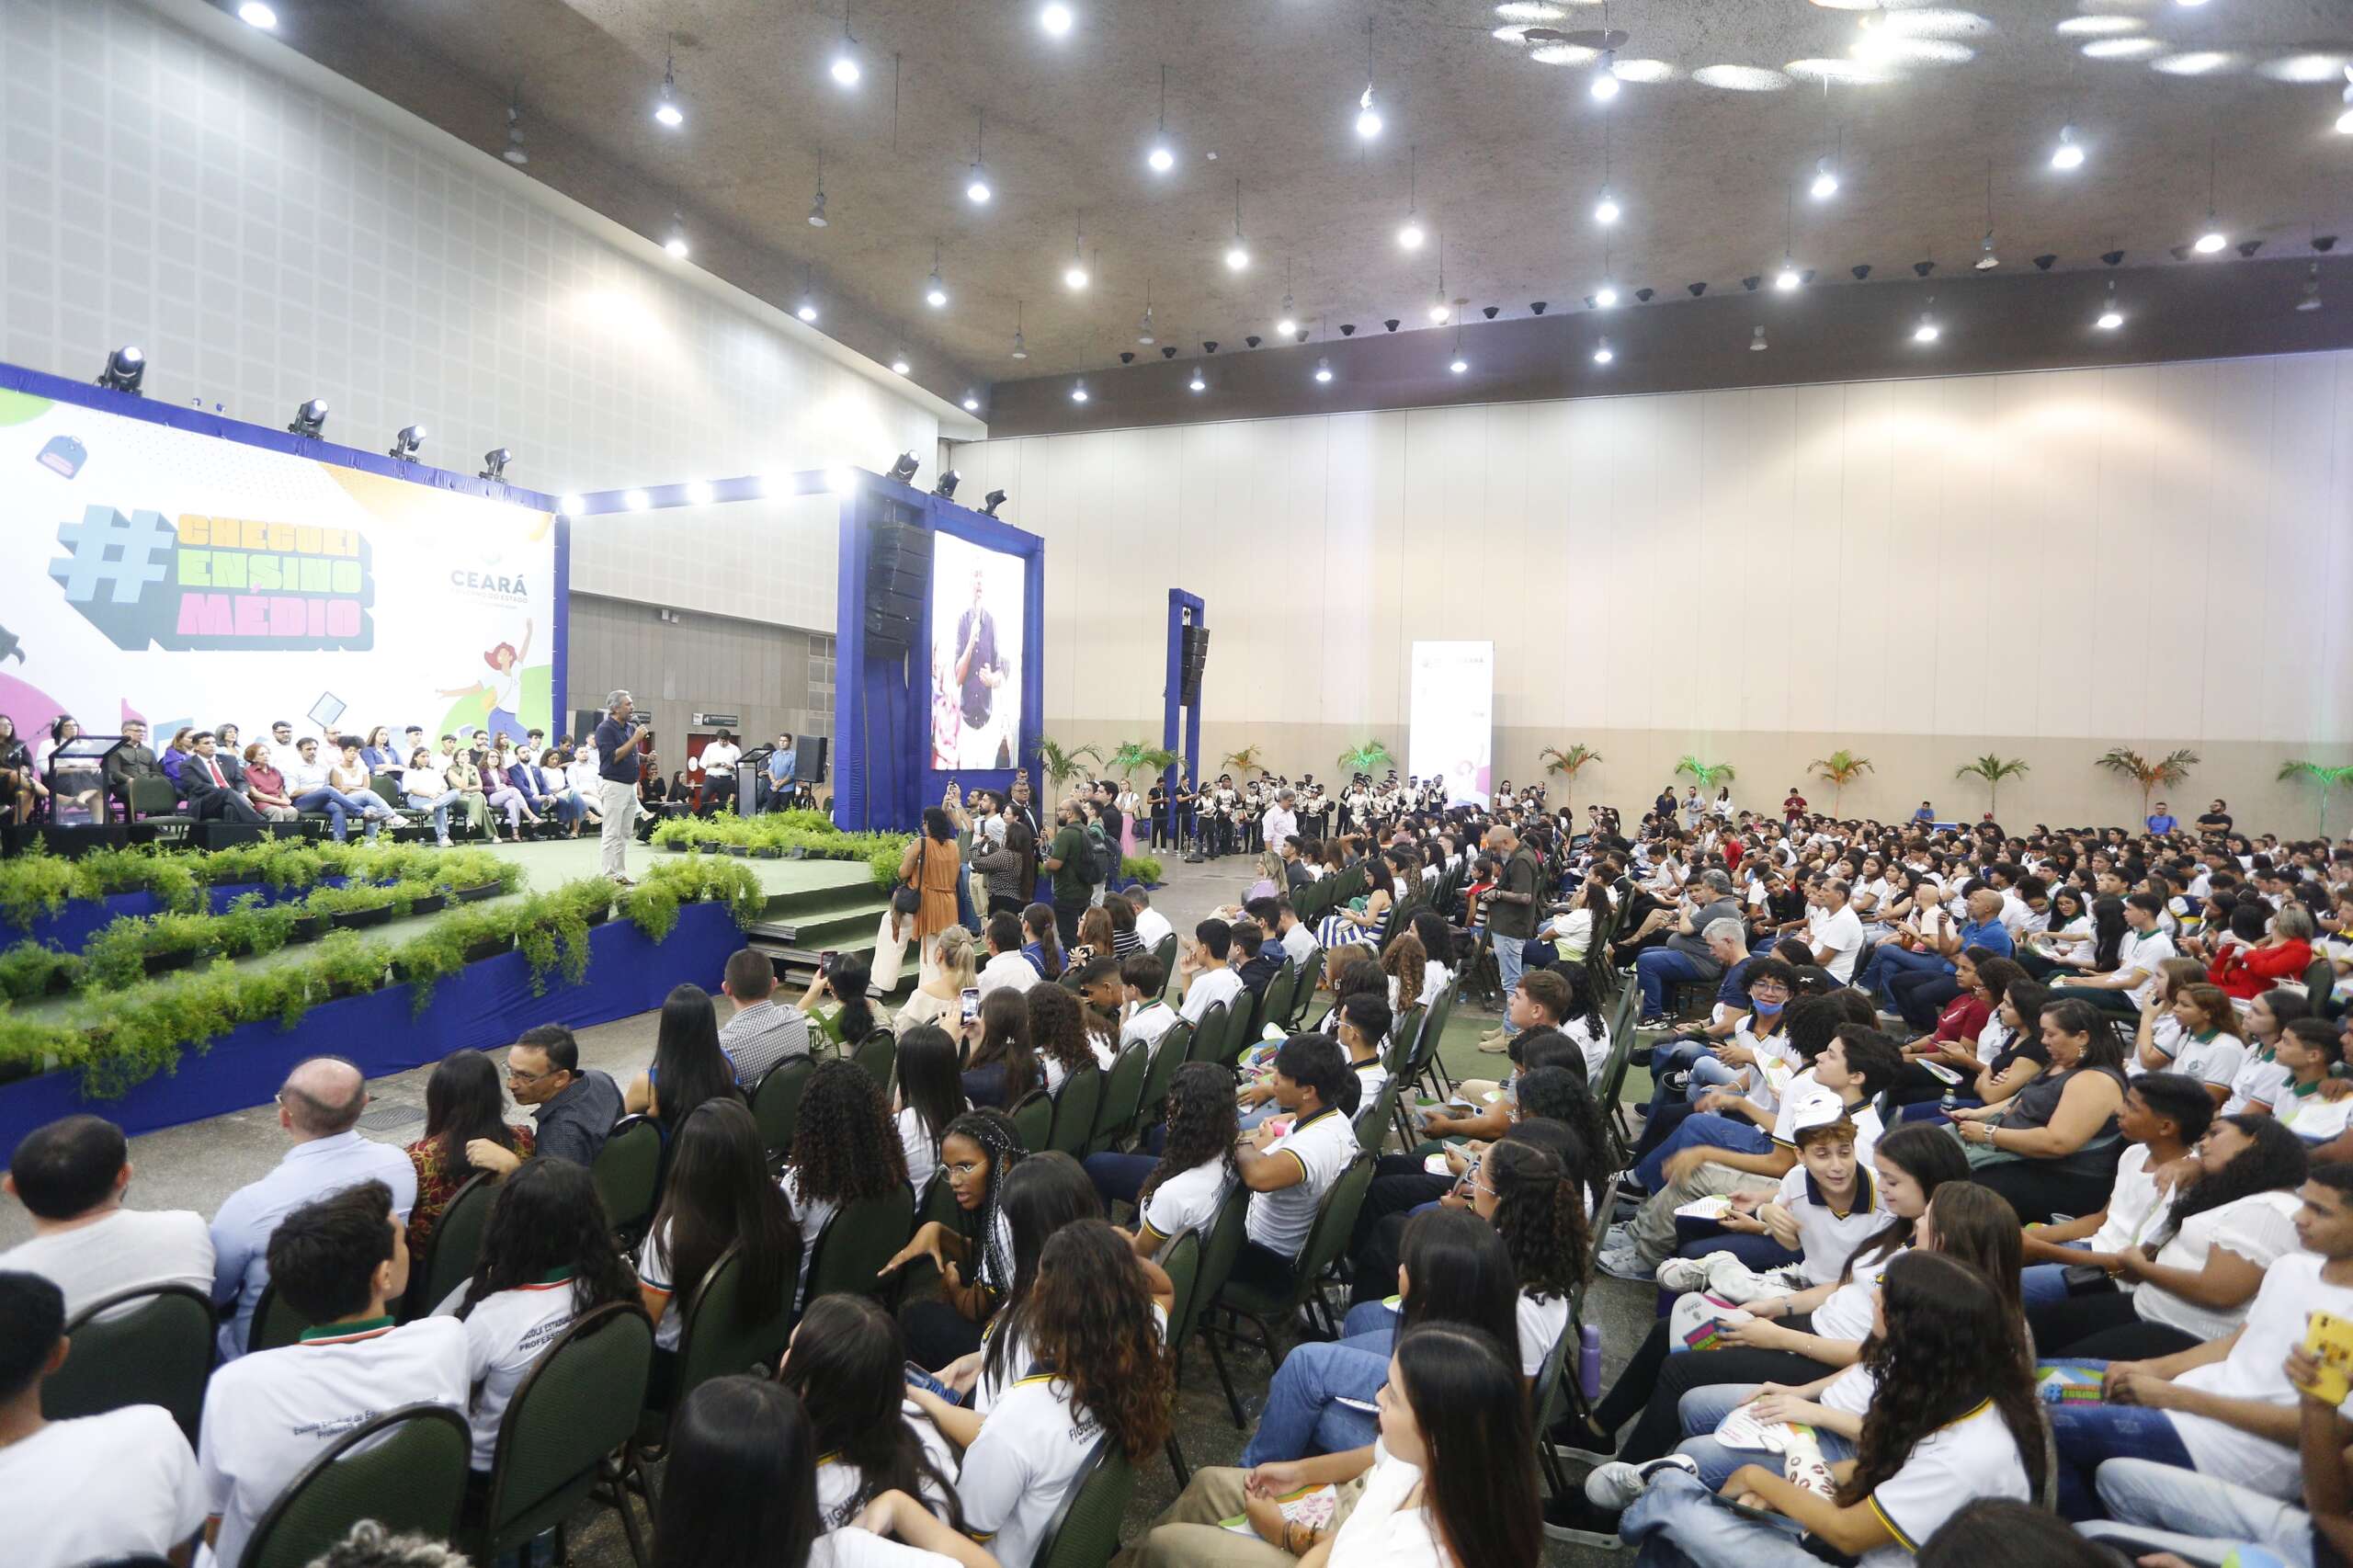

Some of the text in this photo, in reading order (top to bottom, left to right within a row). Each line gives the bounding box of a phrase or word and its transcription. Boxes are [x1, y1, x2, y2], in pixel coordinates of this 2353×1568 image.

[177, 514, 360, 557] CHEGUEI
[177, 549, 362, 594] ENSINO
[450, 570, 528, 596] CEARÁ
[176, 582, 361, 637] MÉDIO
